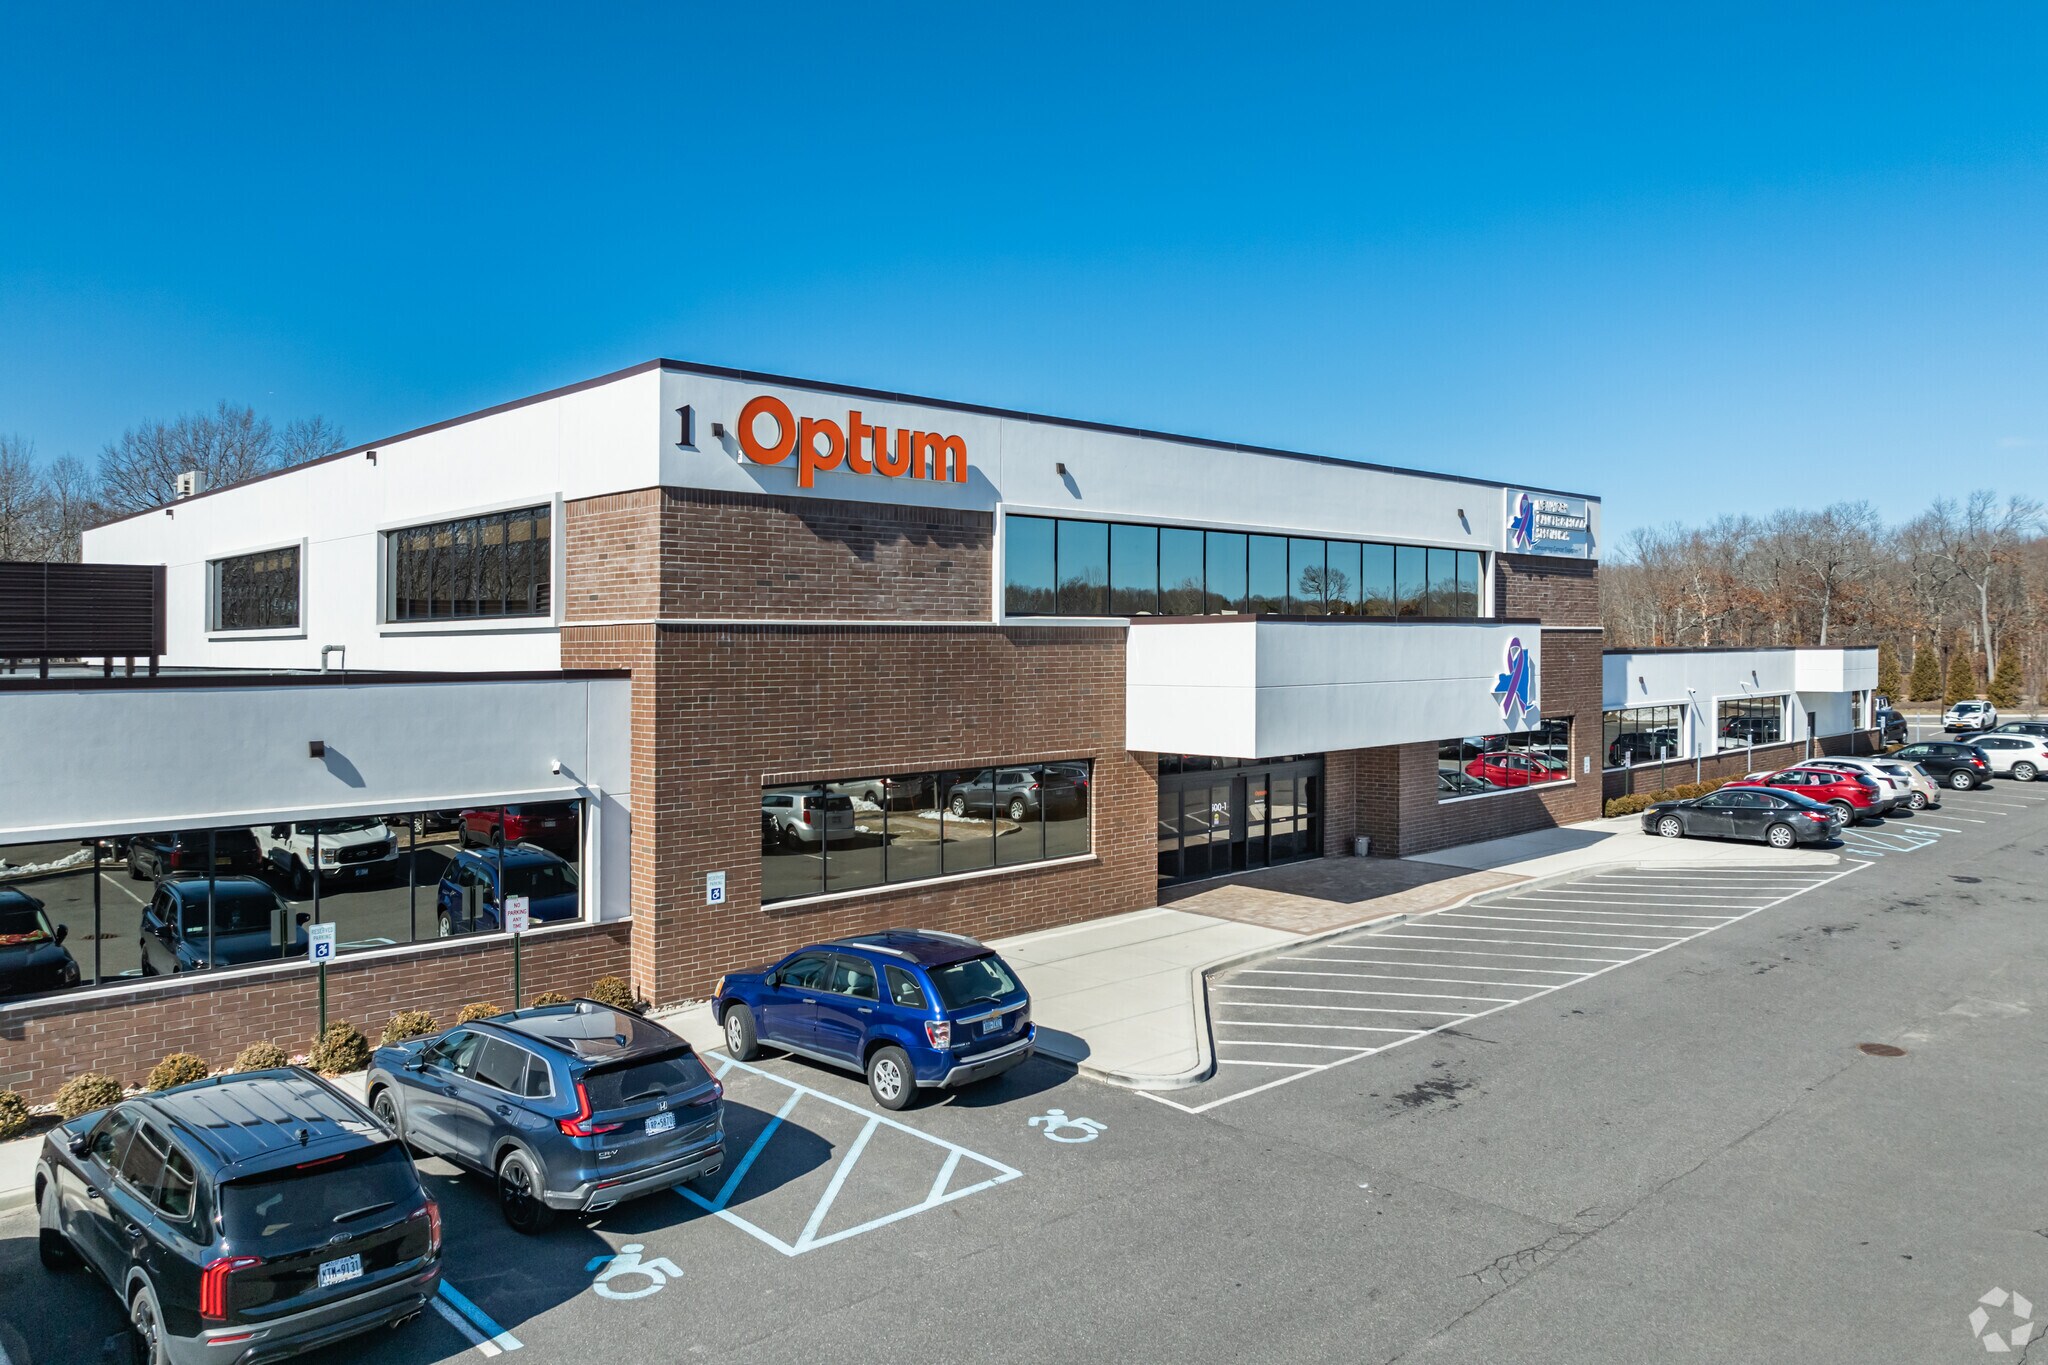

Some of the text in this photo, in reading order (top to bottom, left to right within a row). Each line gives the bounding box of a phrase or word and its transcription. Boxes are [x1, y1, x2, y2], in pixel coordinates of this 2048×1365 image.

[675, 403, 697, 447] 1
[735, 395, 968, 488] Optum
[312, 927, 333, 935] RESERVED
